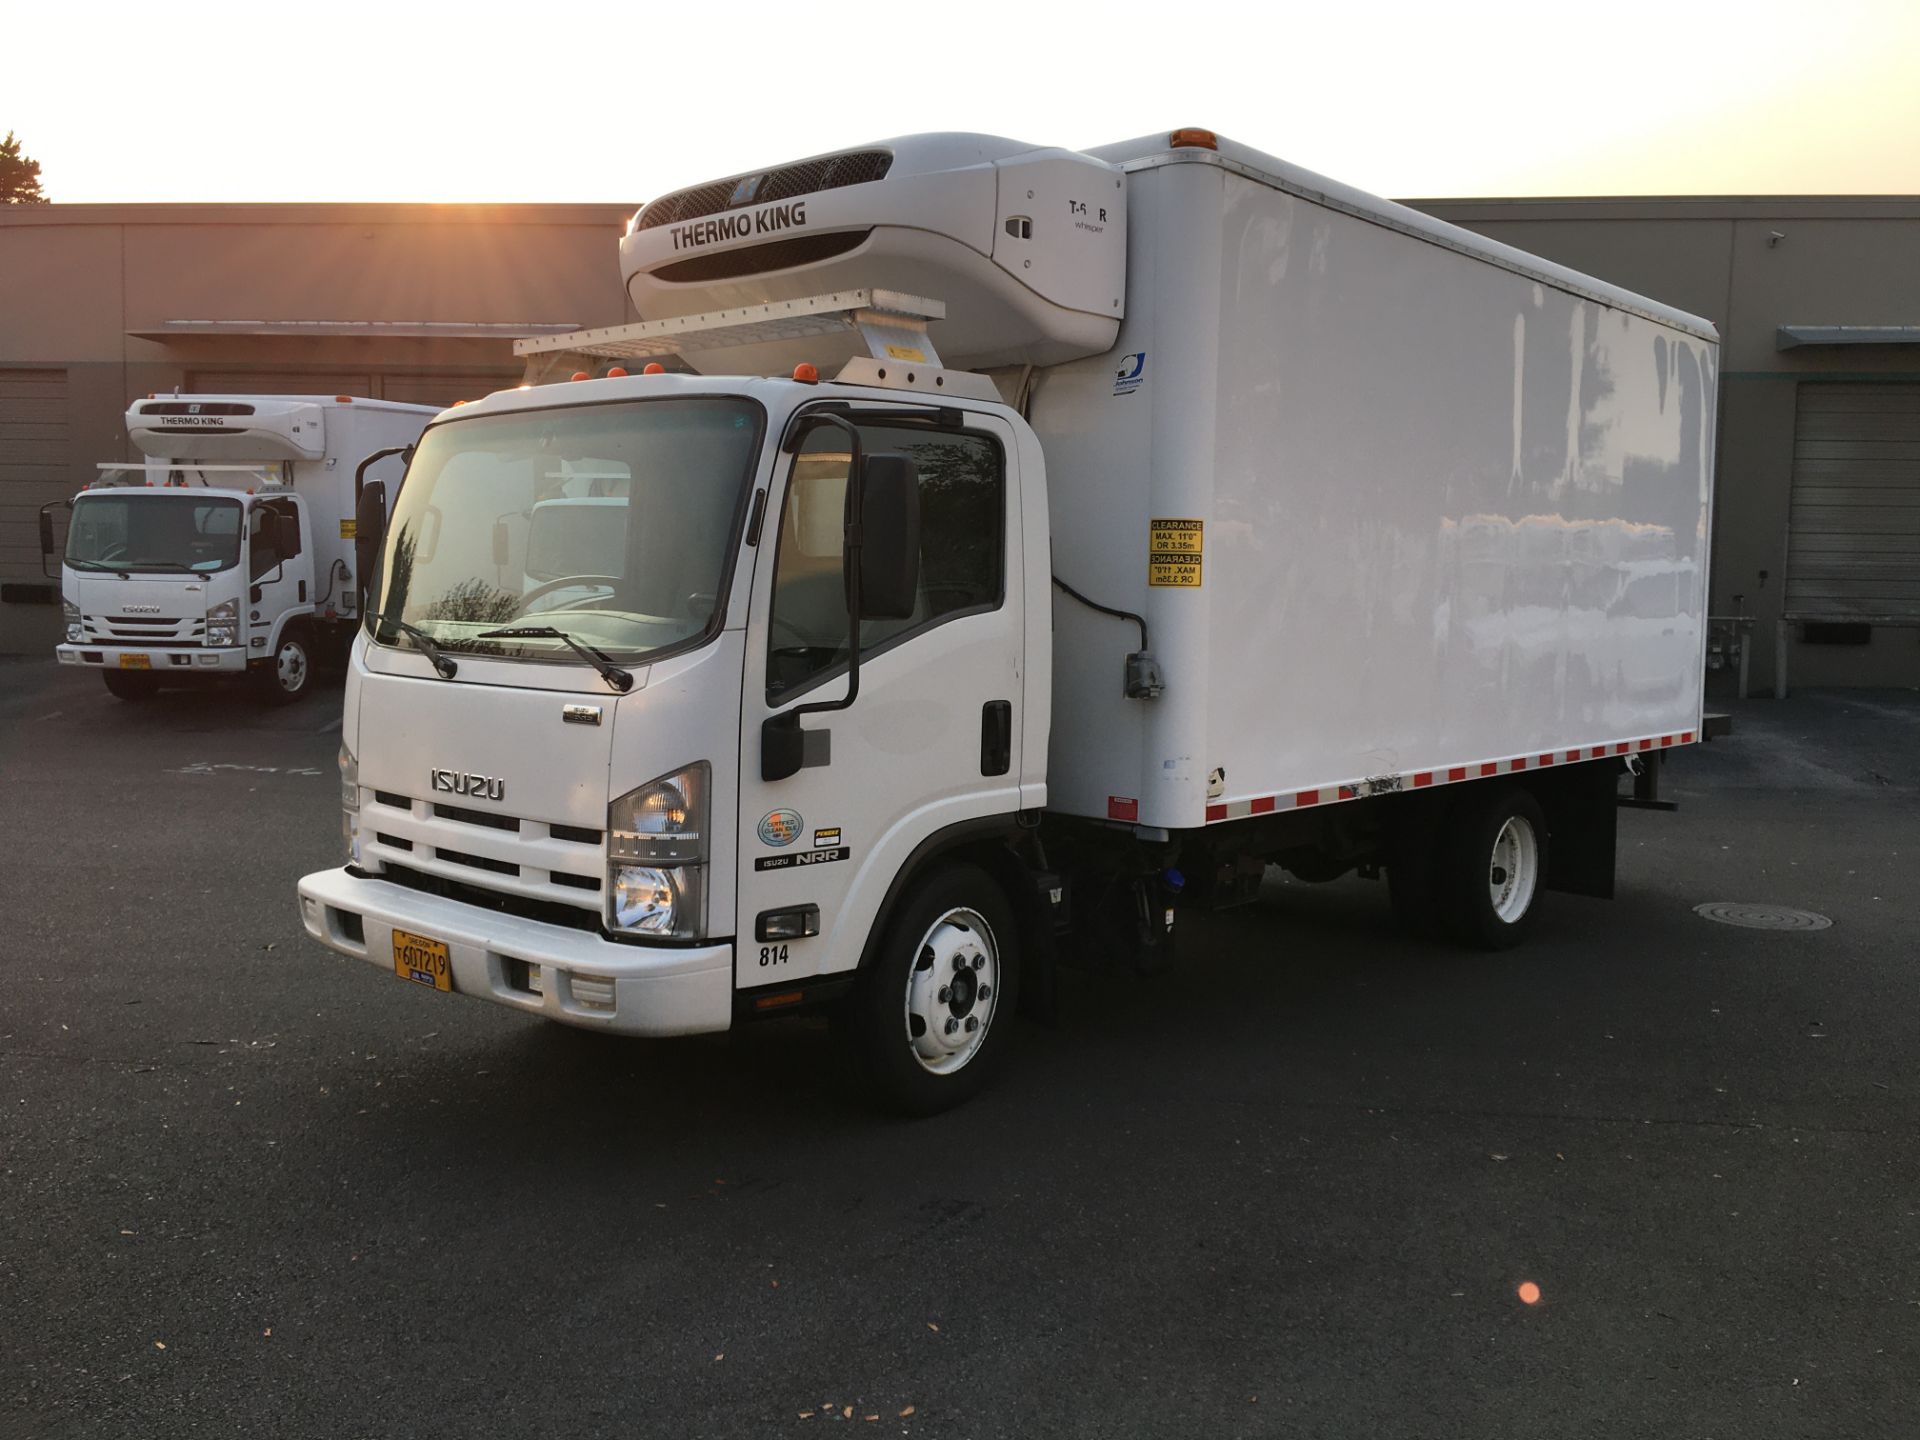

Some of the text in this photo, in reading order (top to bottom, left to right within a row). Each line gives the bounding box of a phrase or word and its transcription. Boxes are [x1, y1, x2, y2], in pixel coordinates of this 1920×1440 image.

[670, 202, 807, 250] THERMO KING
[160, 417, 224, 426] THERMO KING
[1152, 522, 1202, 530] CLEARANCE
[1156, 542, 1194, 550] OR 3.35m
[122, 604, 160, 613] ISUZU
[431, 768, 504, 801] ISUZU
[763, 850, 839, 867] ISUZU NRR
[759, 944, 789, 967] 814
